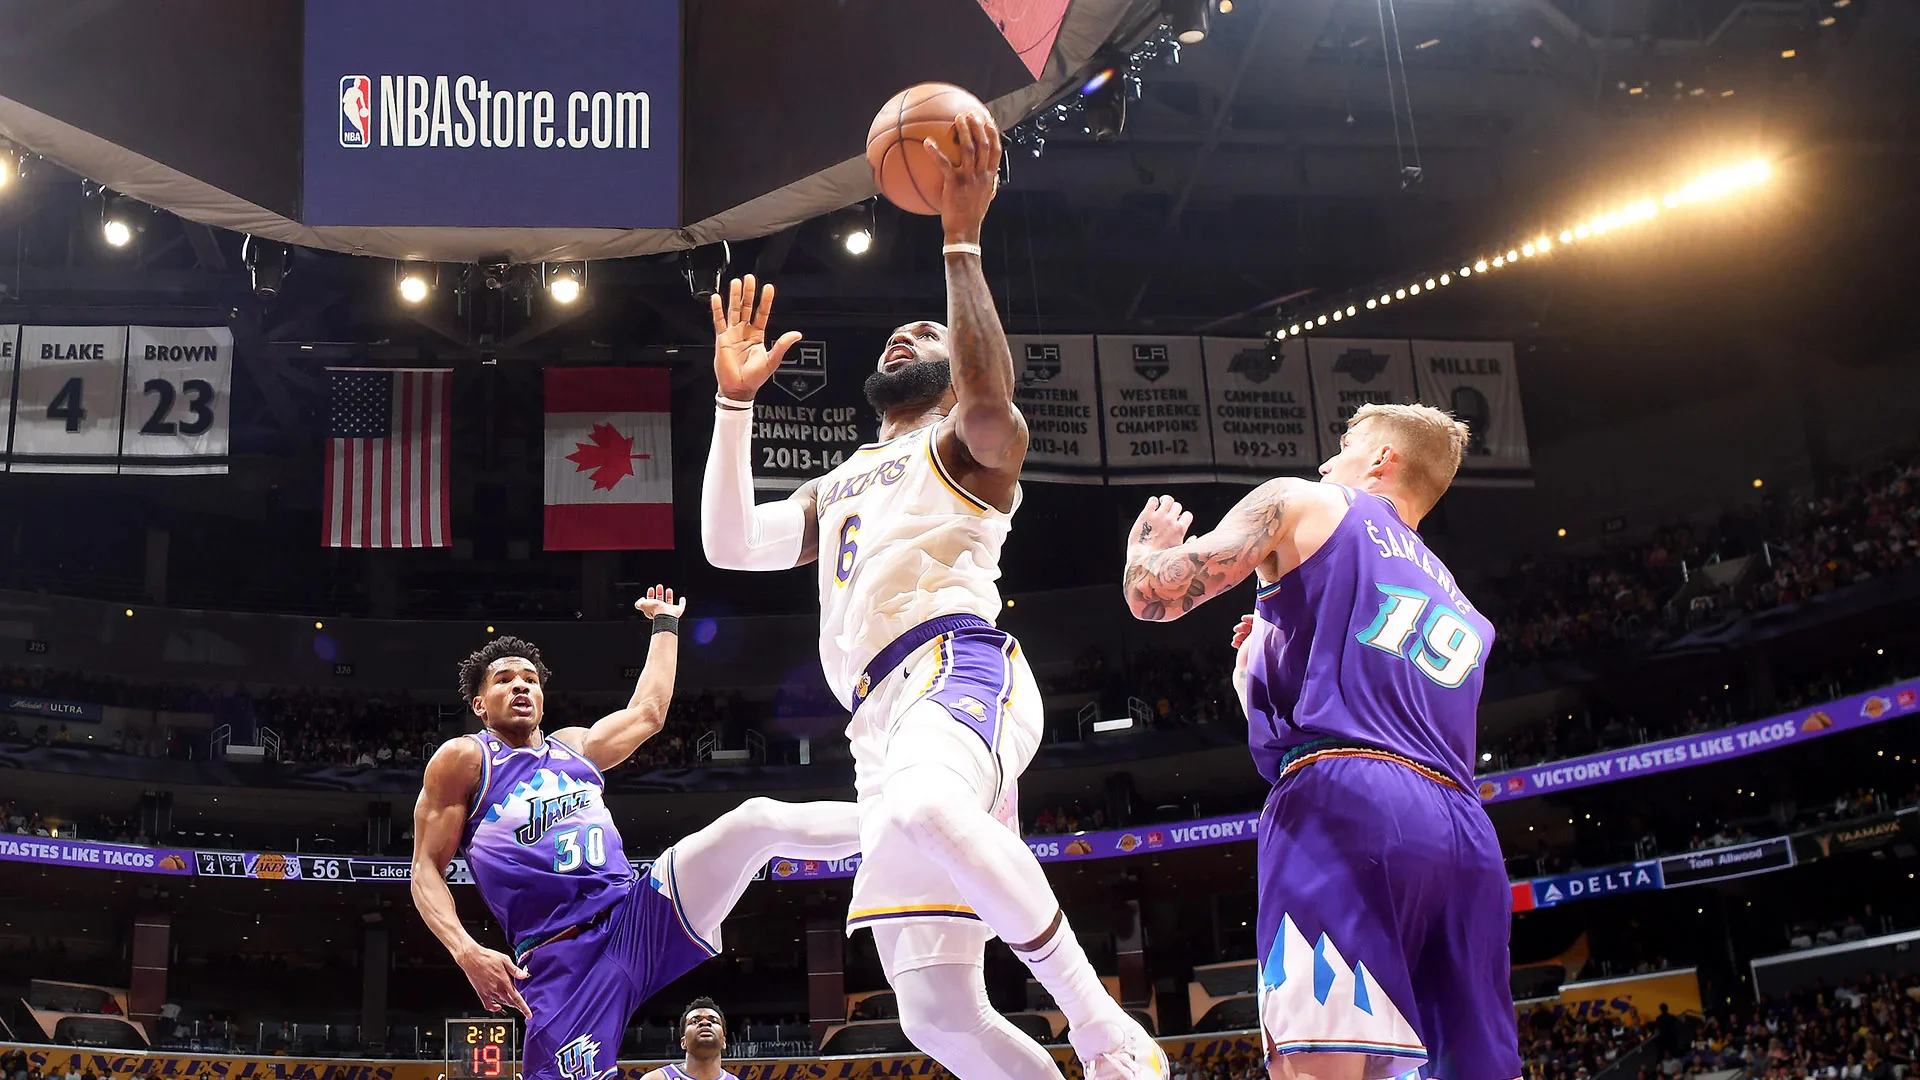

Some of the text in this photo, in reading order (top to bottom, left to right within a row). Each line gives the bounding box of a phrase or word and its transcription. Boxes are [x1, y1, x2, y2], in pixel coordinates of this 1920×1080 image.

[380, 75, 650, 148] NBAStore.com
[344, 131, 361, 142] NBA
[41, 344, 104, 360] BLAKE
[144, 345, 217, 361] BROWN
[1430, 358, 1500, 374] MILLER
[1120, 389, 1188, 401] WESTERN
[1224, 390, 1296, 403] CAMPBELL
[1339, 390, 1391, 402] SMYTHE
[47, 376, 87, 433] 4
[138, 378, 215, 436] 23
[754, 404, 817, 423] TANLEY
[823, 407, 857, 423] CUP
[1110, 405, 1200, 417] CONFERENCE
[1217, 405, 1307, 418] CONFERENCE
[1116, 421, 1199, 434] CHAMPIONS
[1223, 422, 1304, 435] CHAMPIONS
[1131, 439, 1189, 457] 2011-12
[1233, 441, 1298, 457] 1992-93
[763, 447, 844, 470] 2013-14
[835, 512, 862, 587] 6
[1355, 582, 1484, 689] 19
[50, 703, 83, 714] ULTRA
[1532, 760, 1613, 788] VICTORY
[1616, 745, 1687, 772] TASTES
[1690, 736, 1735, 759] LIKE
[1736, 720, 1796, 749] TACOS
[1171, 821, 1245, 843] VICTORY
[0, 841, 154, 867] TASTES LIKE TACOS
[553, 823, 607, 873] 30
[1690, 848, 1762, 869] Tom Allwood
[206, 862, 236, 874] 4 1
[312, 860, 340, 879] 56
[1569, 869, 1650, 896] DELTA
[467, 1026, 506, 1044] 2:12
[473, 1044, 500, 1075] 19
